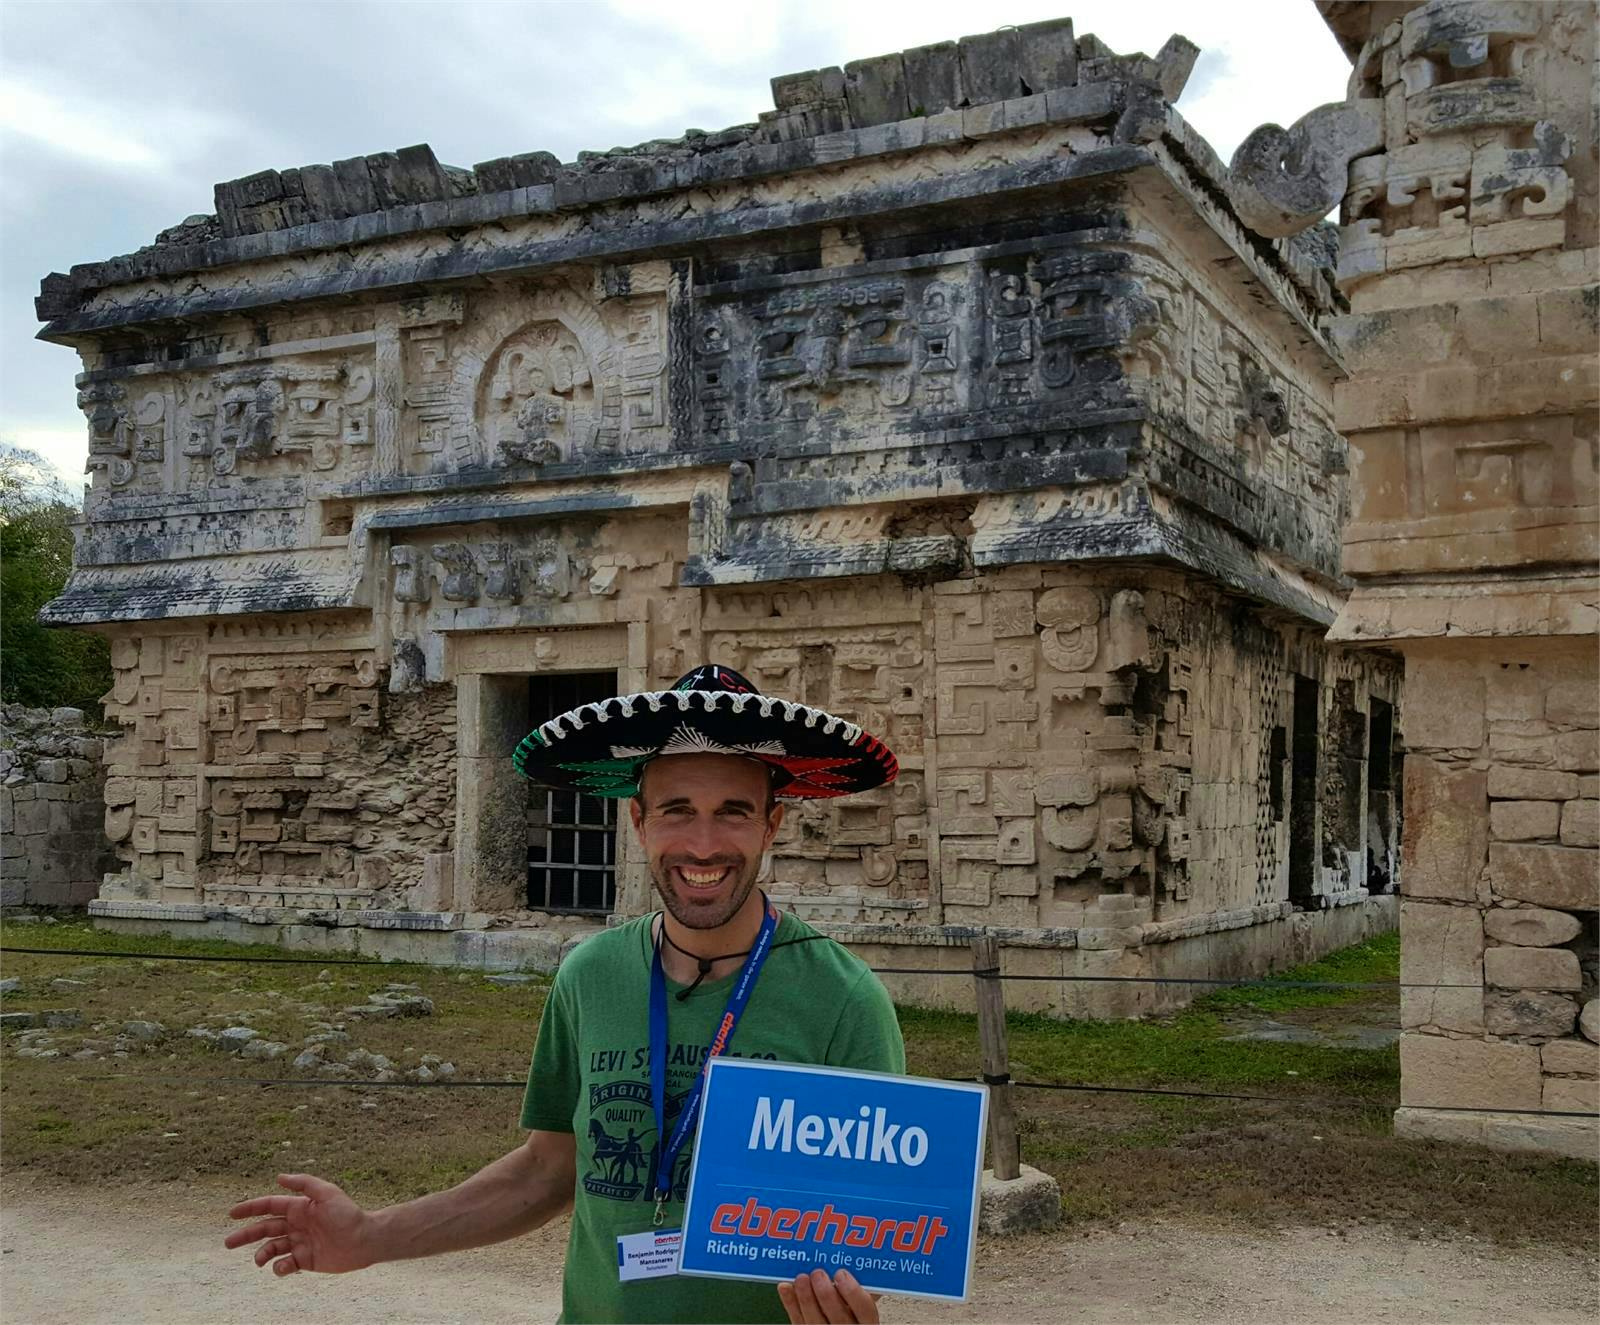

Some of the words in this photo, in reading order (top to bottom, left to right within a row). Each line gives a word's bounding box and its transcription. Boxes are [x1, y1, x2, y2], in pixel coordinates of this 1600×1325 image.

[590, 1050, 625, 1073] LEVI
[605, 1108, 646, 1123] QUALITY
[748, 1096, 929, 1167] Mexiko
[710, 1198, 948, 1255] eberhardt
[707, 1240, 758, 1262] Richtig
[762, 1246, 811, 1262] reisen.
[814, 1249, 827, 1263] In
[831, 1250, 852, 1266] die
[856, 1256, 897, 1271] ganze
[900, 1259, 934, 1276] Welt.
